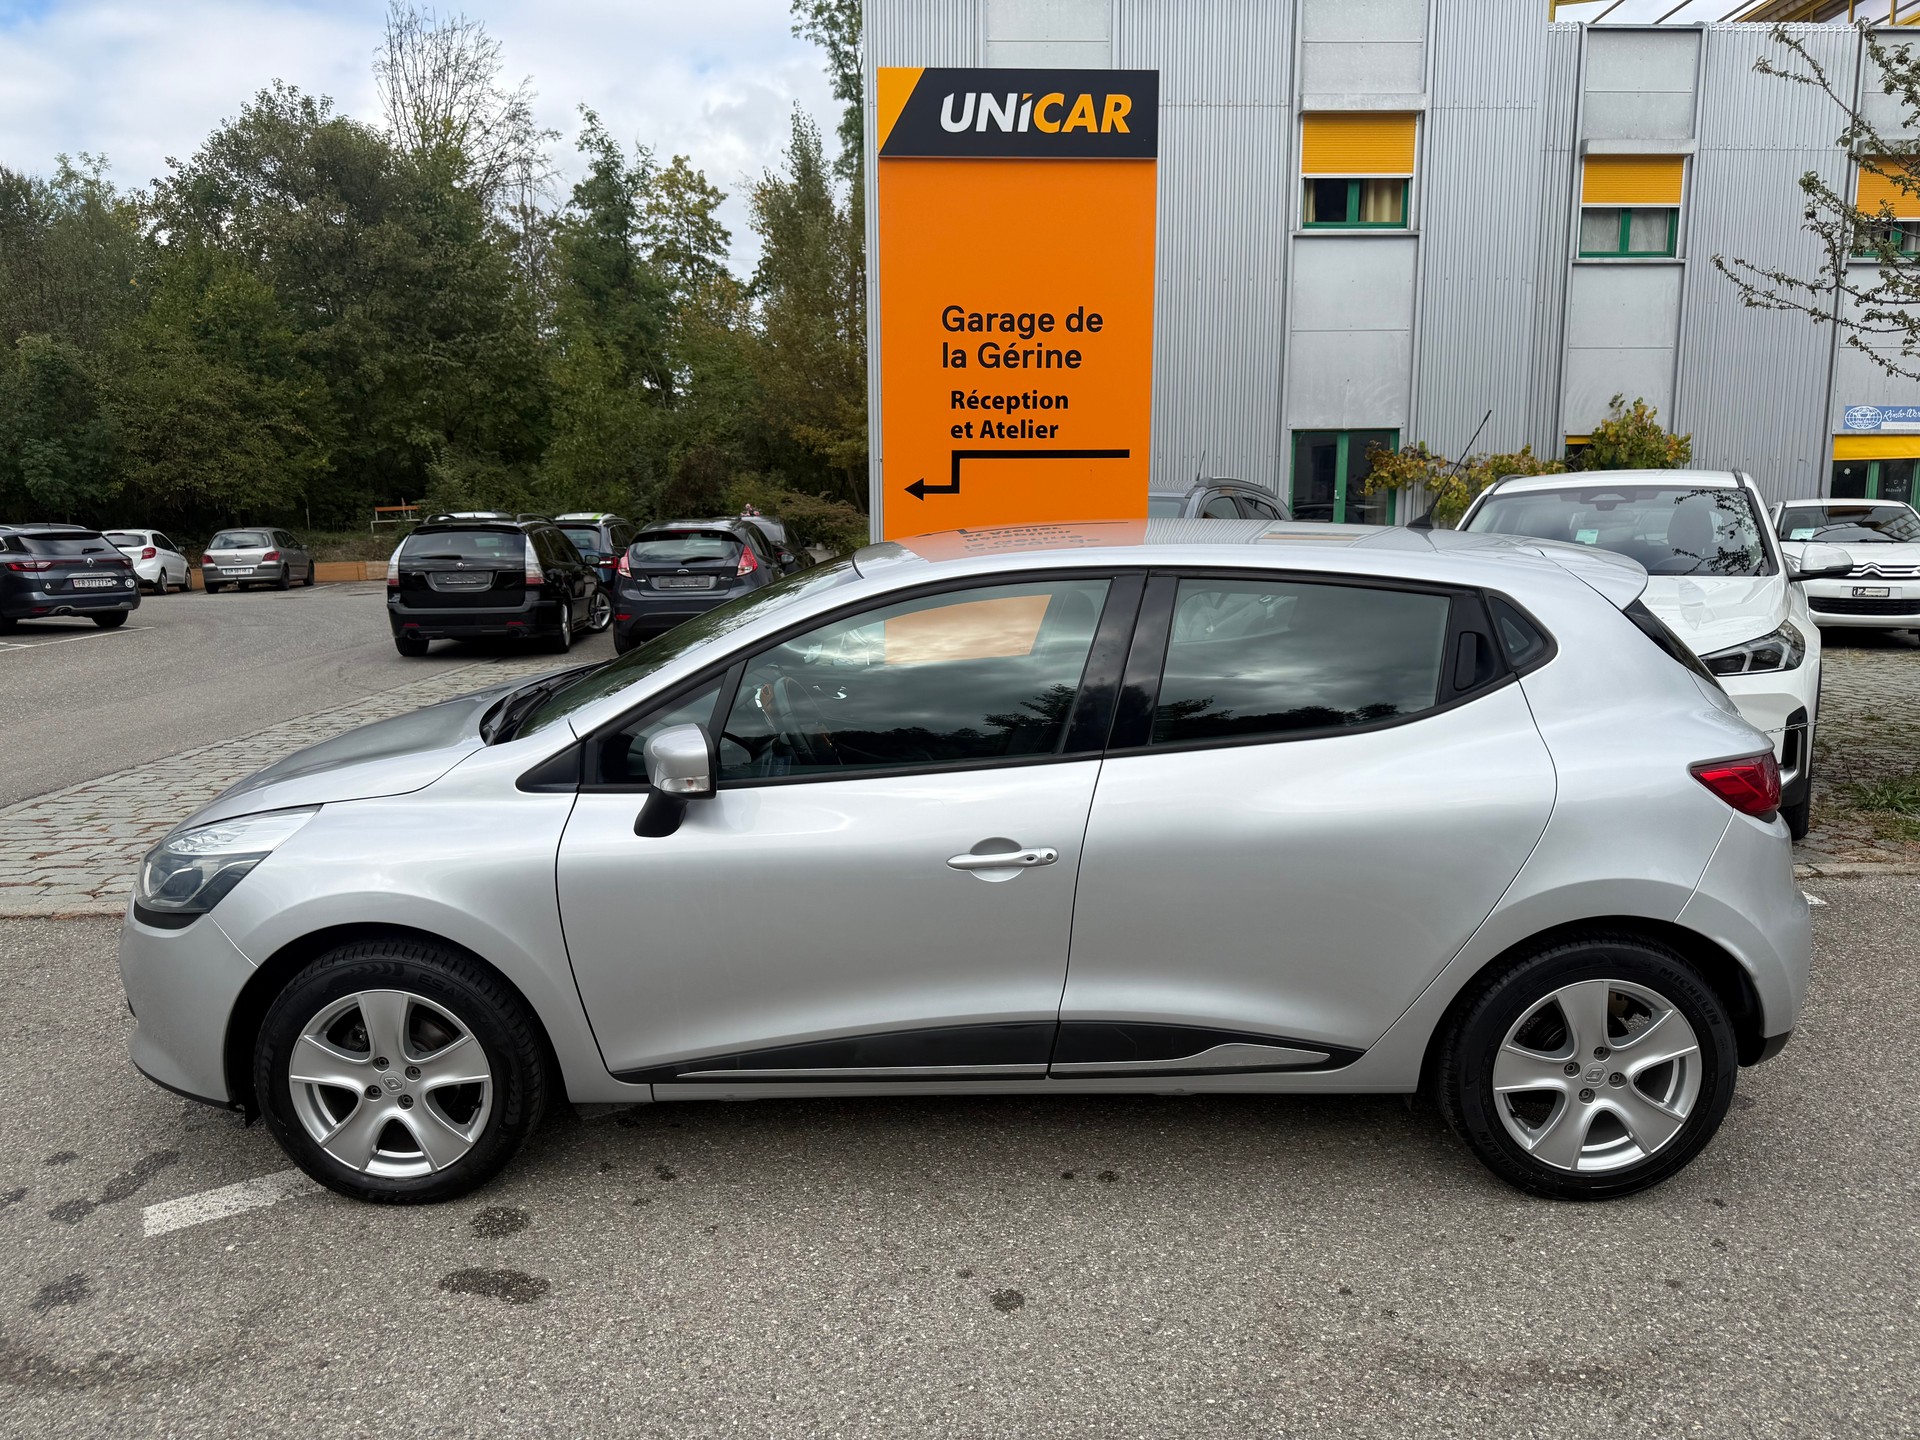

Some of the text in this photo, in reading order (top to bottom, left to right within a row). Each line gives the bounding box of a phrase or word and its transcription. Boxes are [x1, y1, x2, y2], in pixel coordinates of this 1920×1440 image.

[942, 305, 1103, 340] Garage de
[943, 342, 1082, 369] la Gérine
[951, 390, 1068, 414] Réception
[951, 419, 1058, 439] et Atelier
